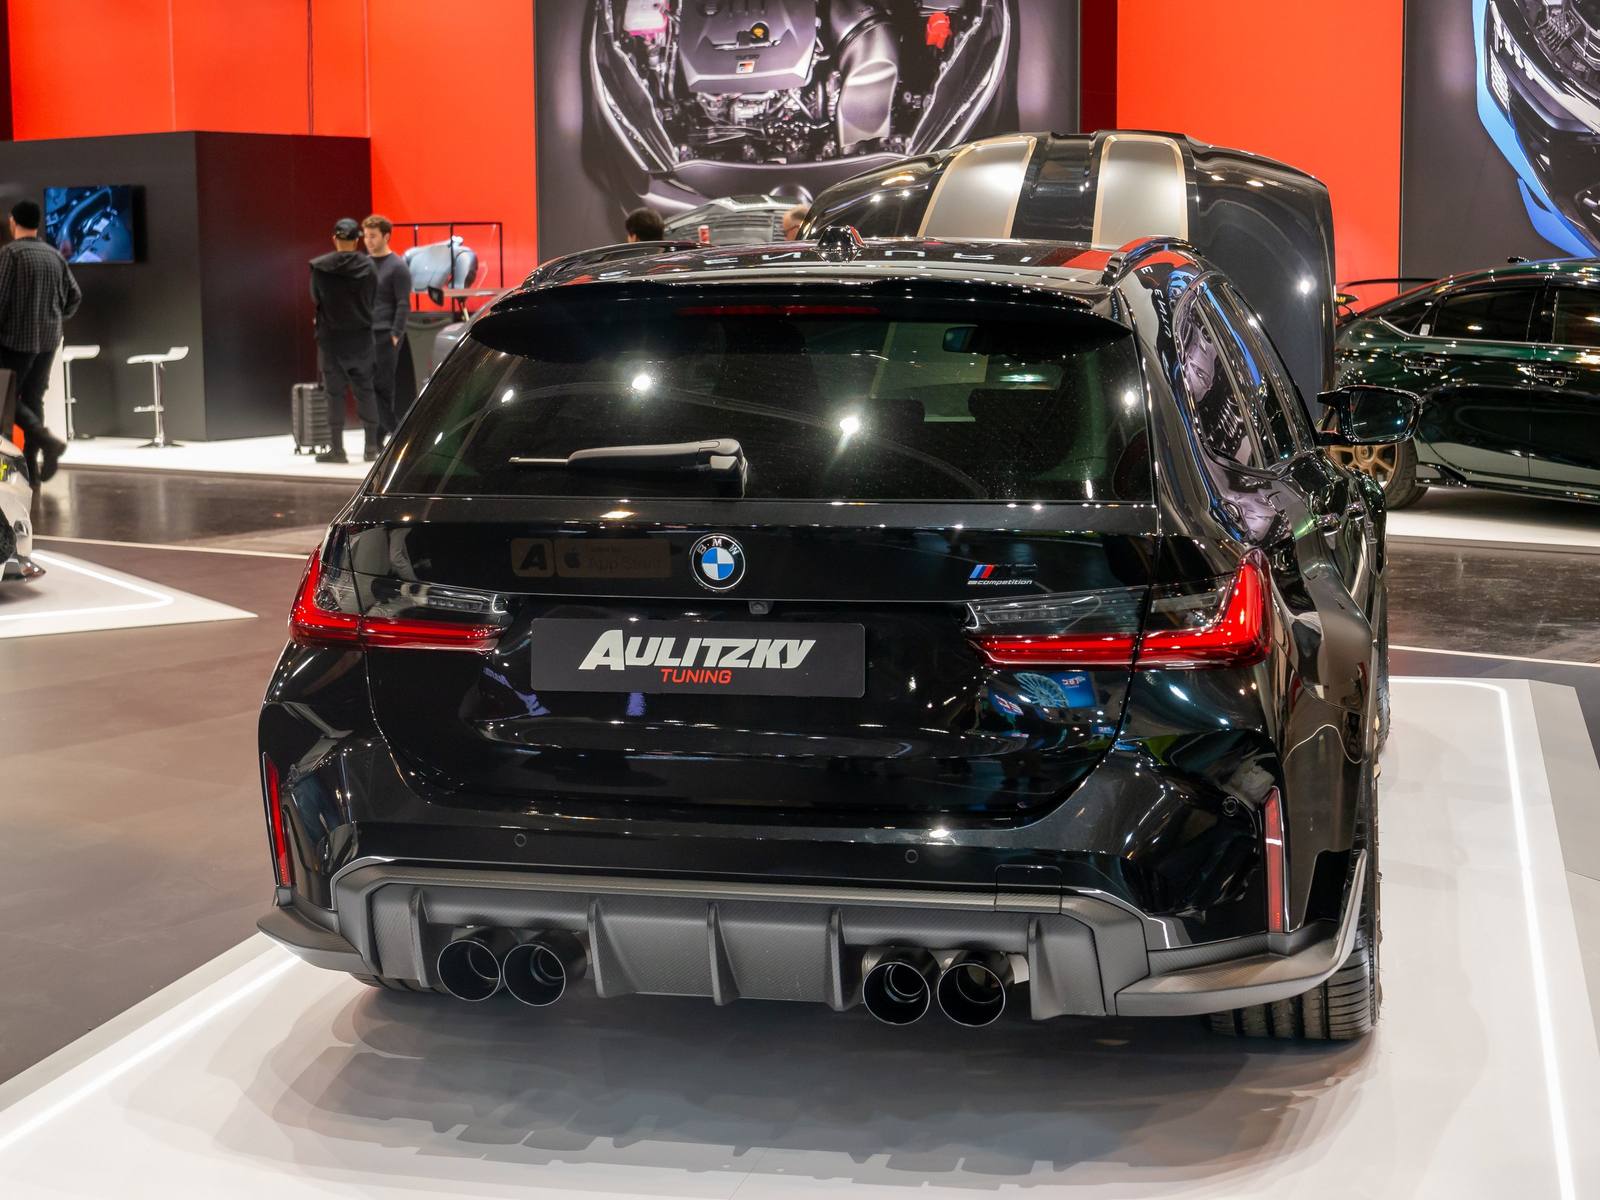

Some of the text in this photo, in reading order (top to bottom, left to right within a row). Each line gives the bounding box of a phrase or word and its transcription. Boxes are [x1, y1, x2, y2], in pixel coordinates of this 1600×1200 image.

[696, 538, 740, 556] BMW
[578, 629, 817, 671] AULITZKY
[660, 668, 733, 685] TUNING
